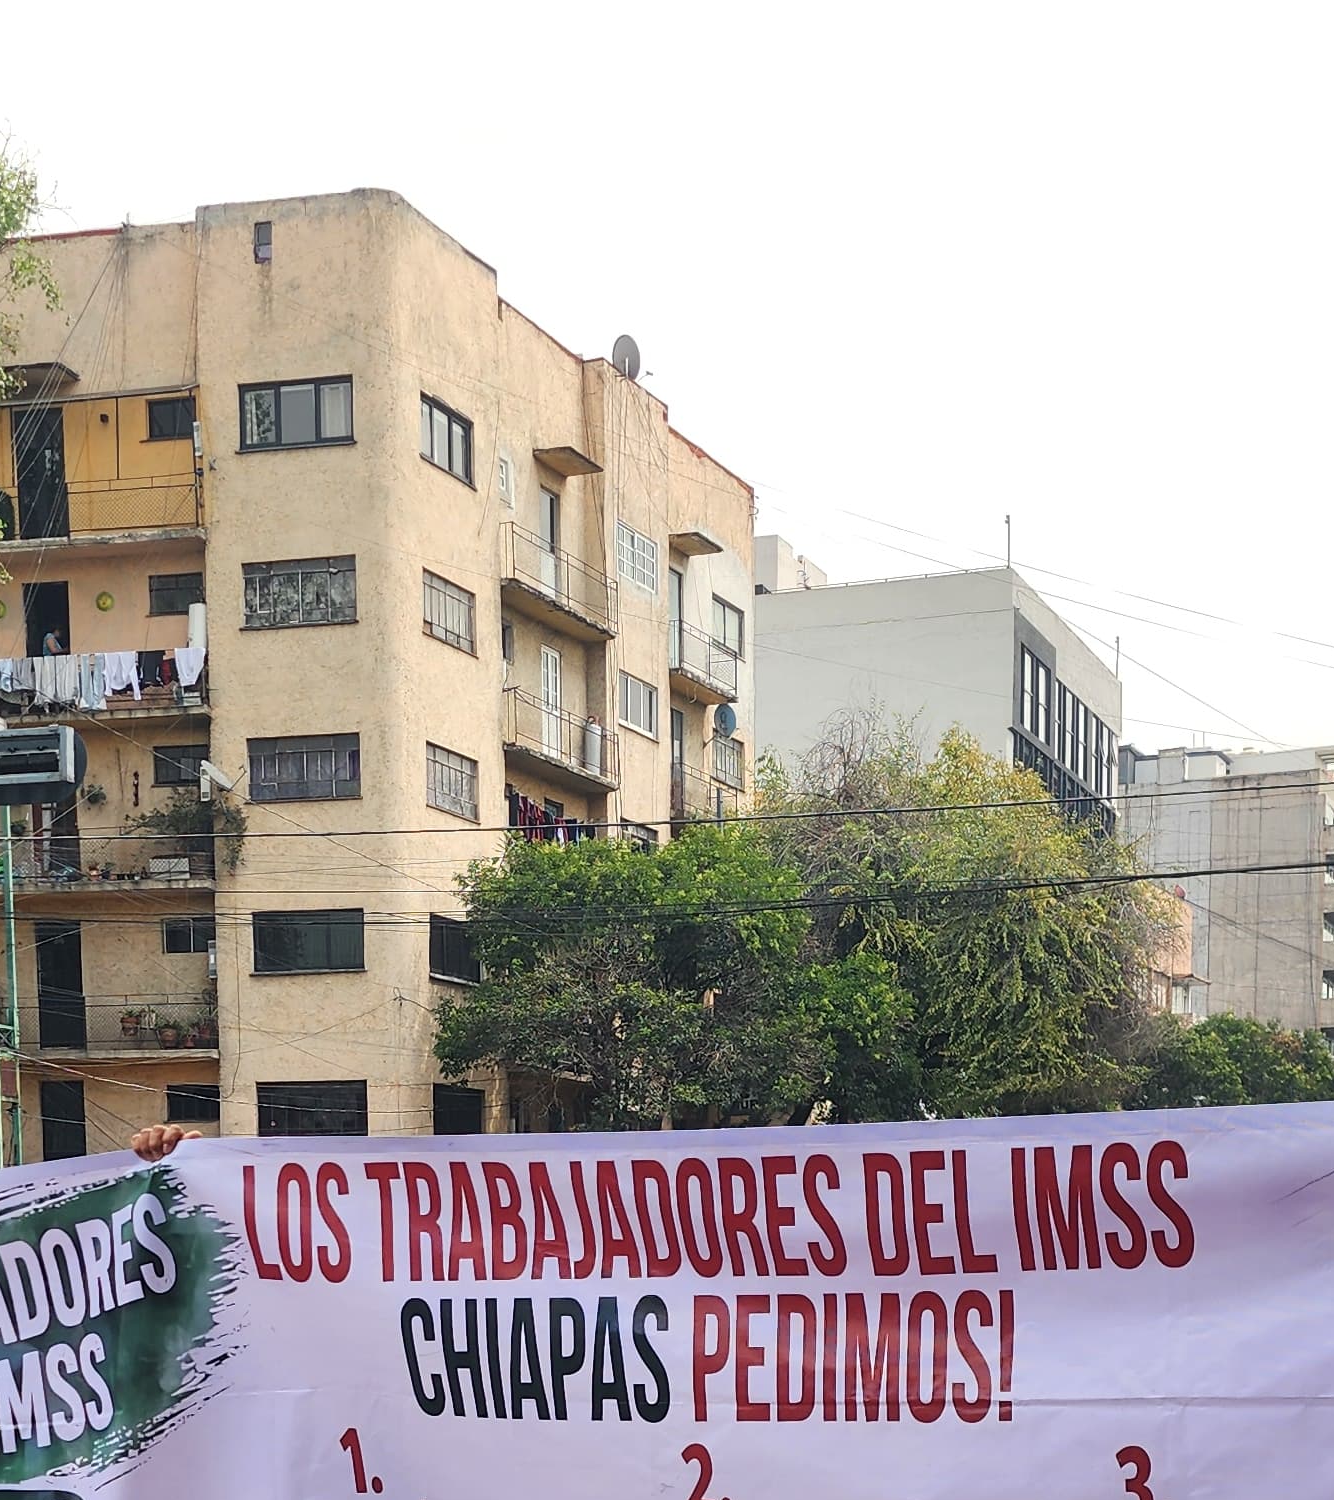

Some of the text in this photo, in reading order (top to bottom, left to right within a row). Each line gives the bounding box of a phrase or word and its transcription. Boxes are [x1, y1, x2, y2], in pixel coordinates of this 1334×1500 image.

[243, 1140, 1195, 1283] LOS TRABAJADORES DEL IMSS
[400, 1289, 1015, 1424] CHIAPAS PEDIMOS!
[339, 1427, 383, 1494] 1.
